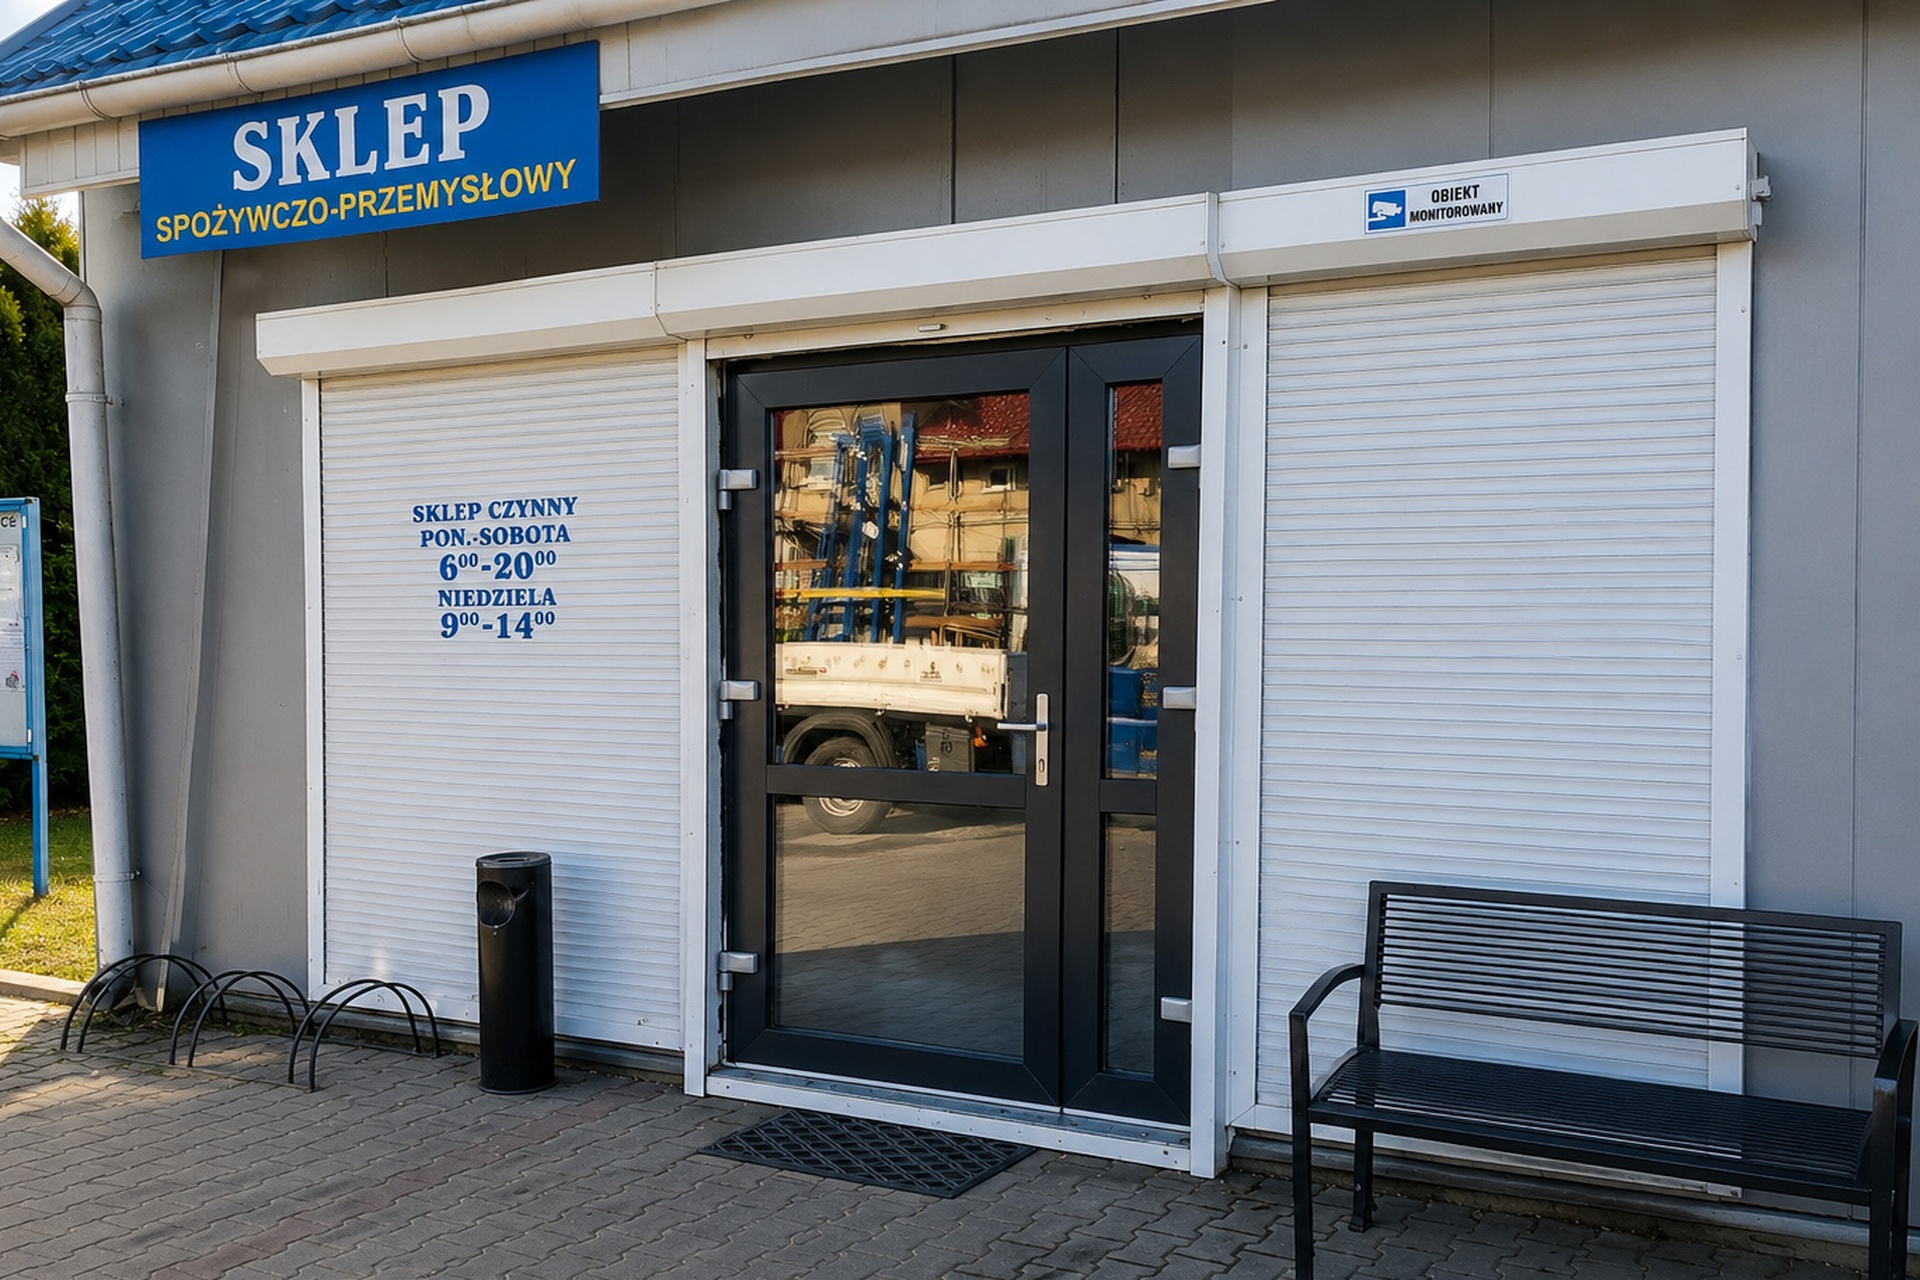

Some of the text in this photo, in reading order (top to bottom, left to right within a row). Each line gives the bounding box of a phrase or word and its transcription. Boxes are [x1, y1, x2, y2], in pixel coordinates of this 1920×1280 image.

[232, 83, 491, 192] SKLEP
[156, 158, 577, 243] SPOŻYWCZO-PRZEMYSŁOWY
[1431, 184, 1480, 204] OBIEKT
[1409, 201, 1504, 223] MONITOROWANY
[412, 496, 578, 523] SKLEP CZYNNY
[438, 587, 557, 607] NIEDZIELA
